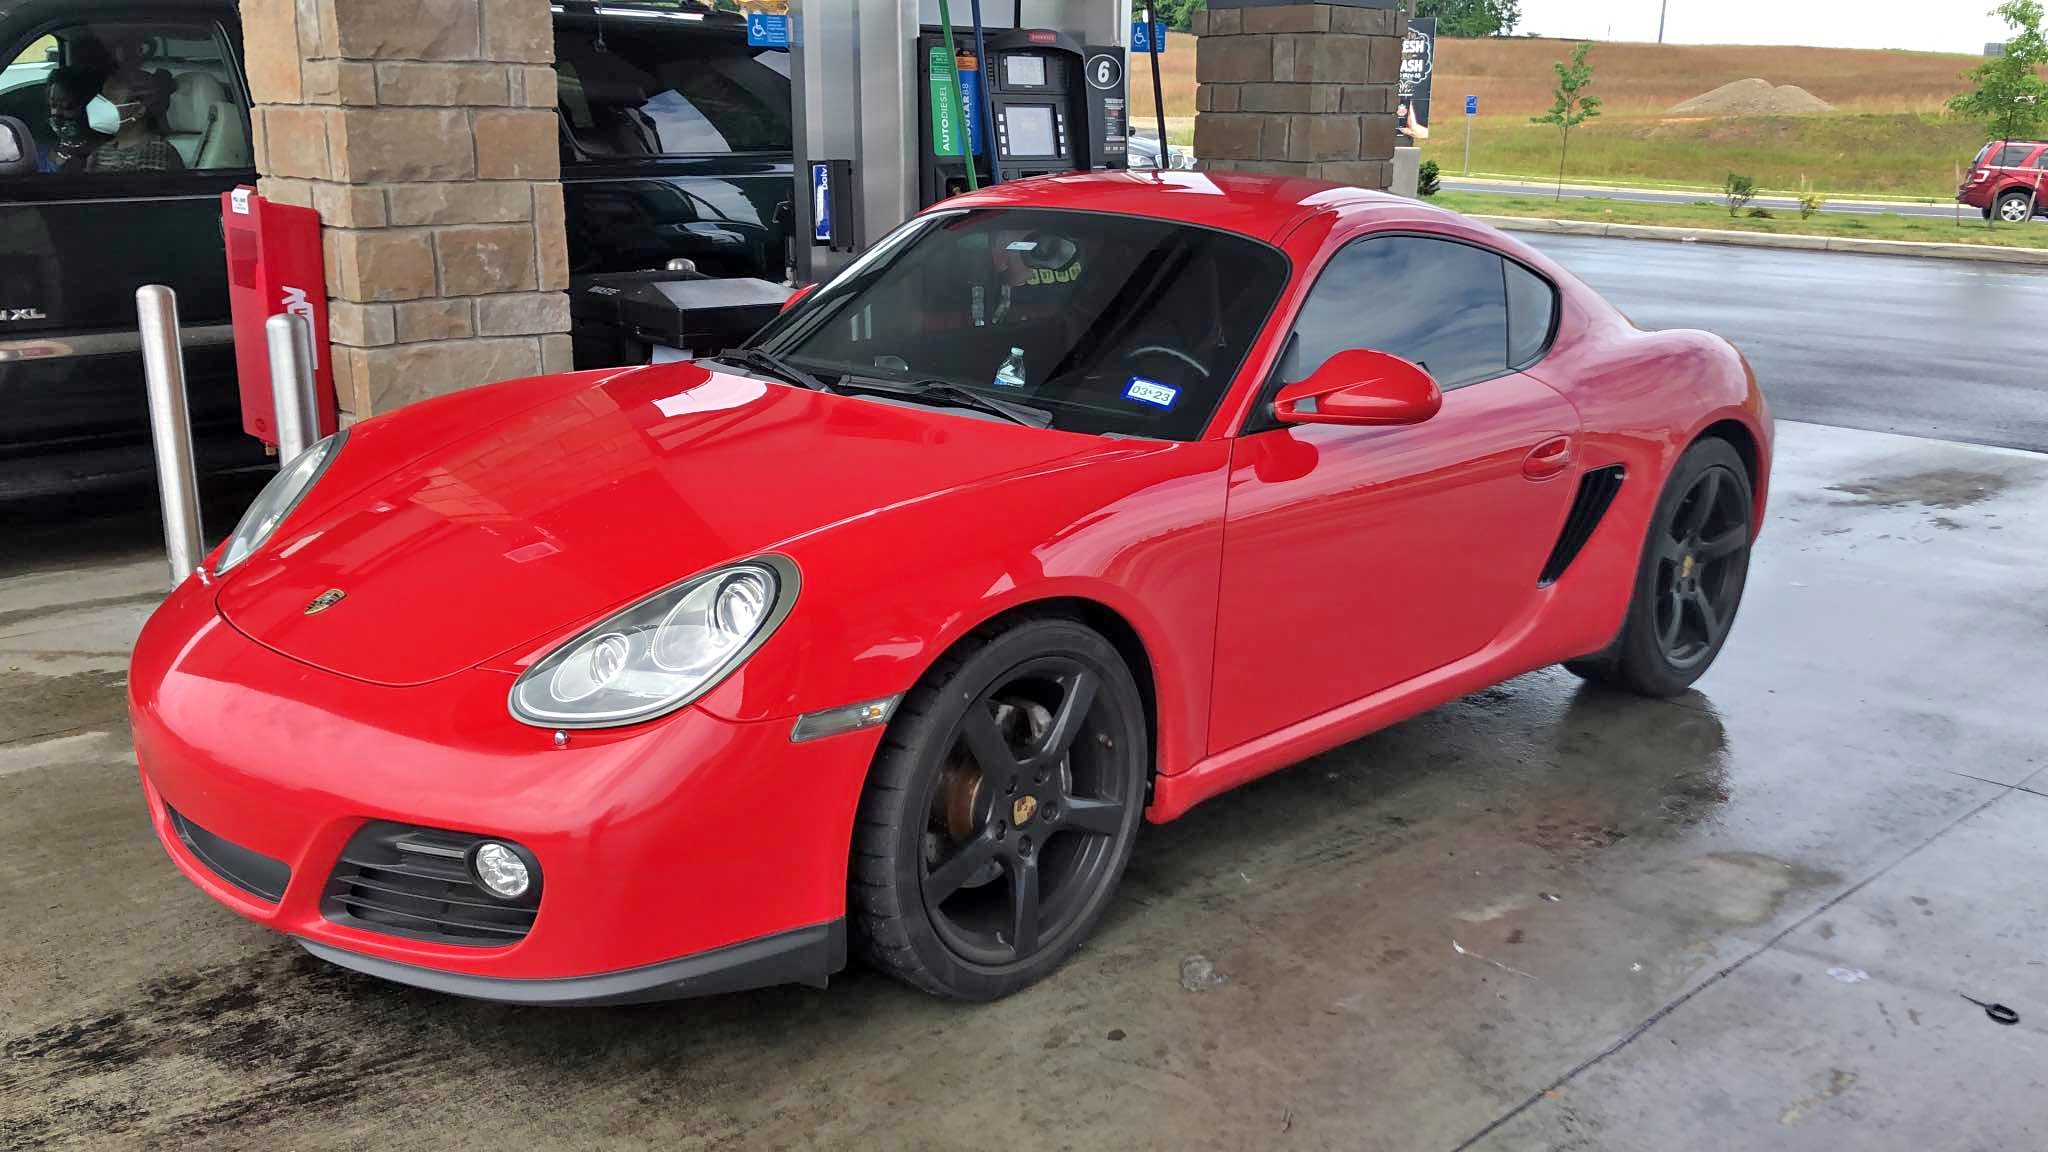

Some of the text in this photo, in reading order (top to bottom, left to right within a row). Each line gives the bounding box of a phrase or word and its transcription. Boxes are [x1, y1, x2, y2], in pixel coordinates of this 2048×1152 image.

[1402, 40, 1425, 53] ESH
[1097, 60, 1110, 83] 6
[1400, 60, 1423, 72] ASH
[940, 87, 950, 151] AUTODIESEL
